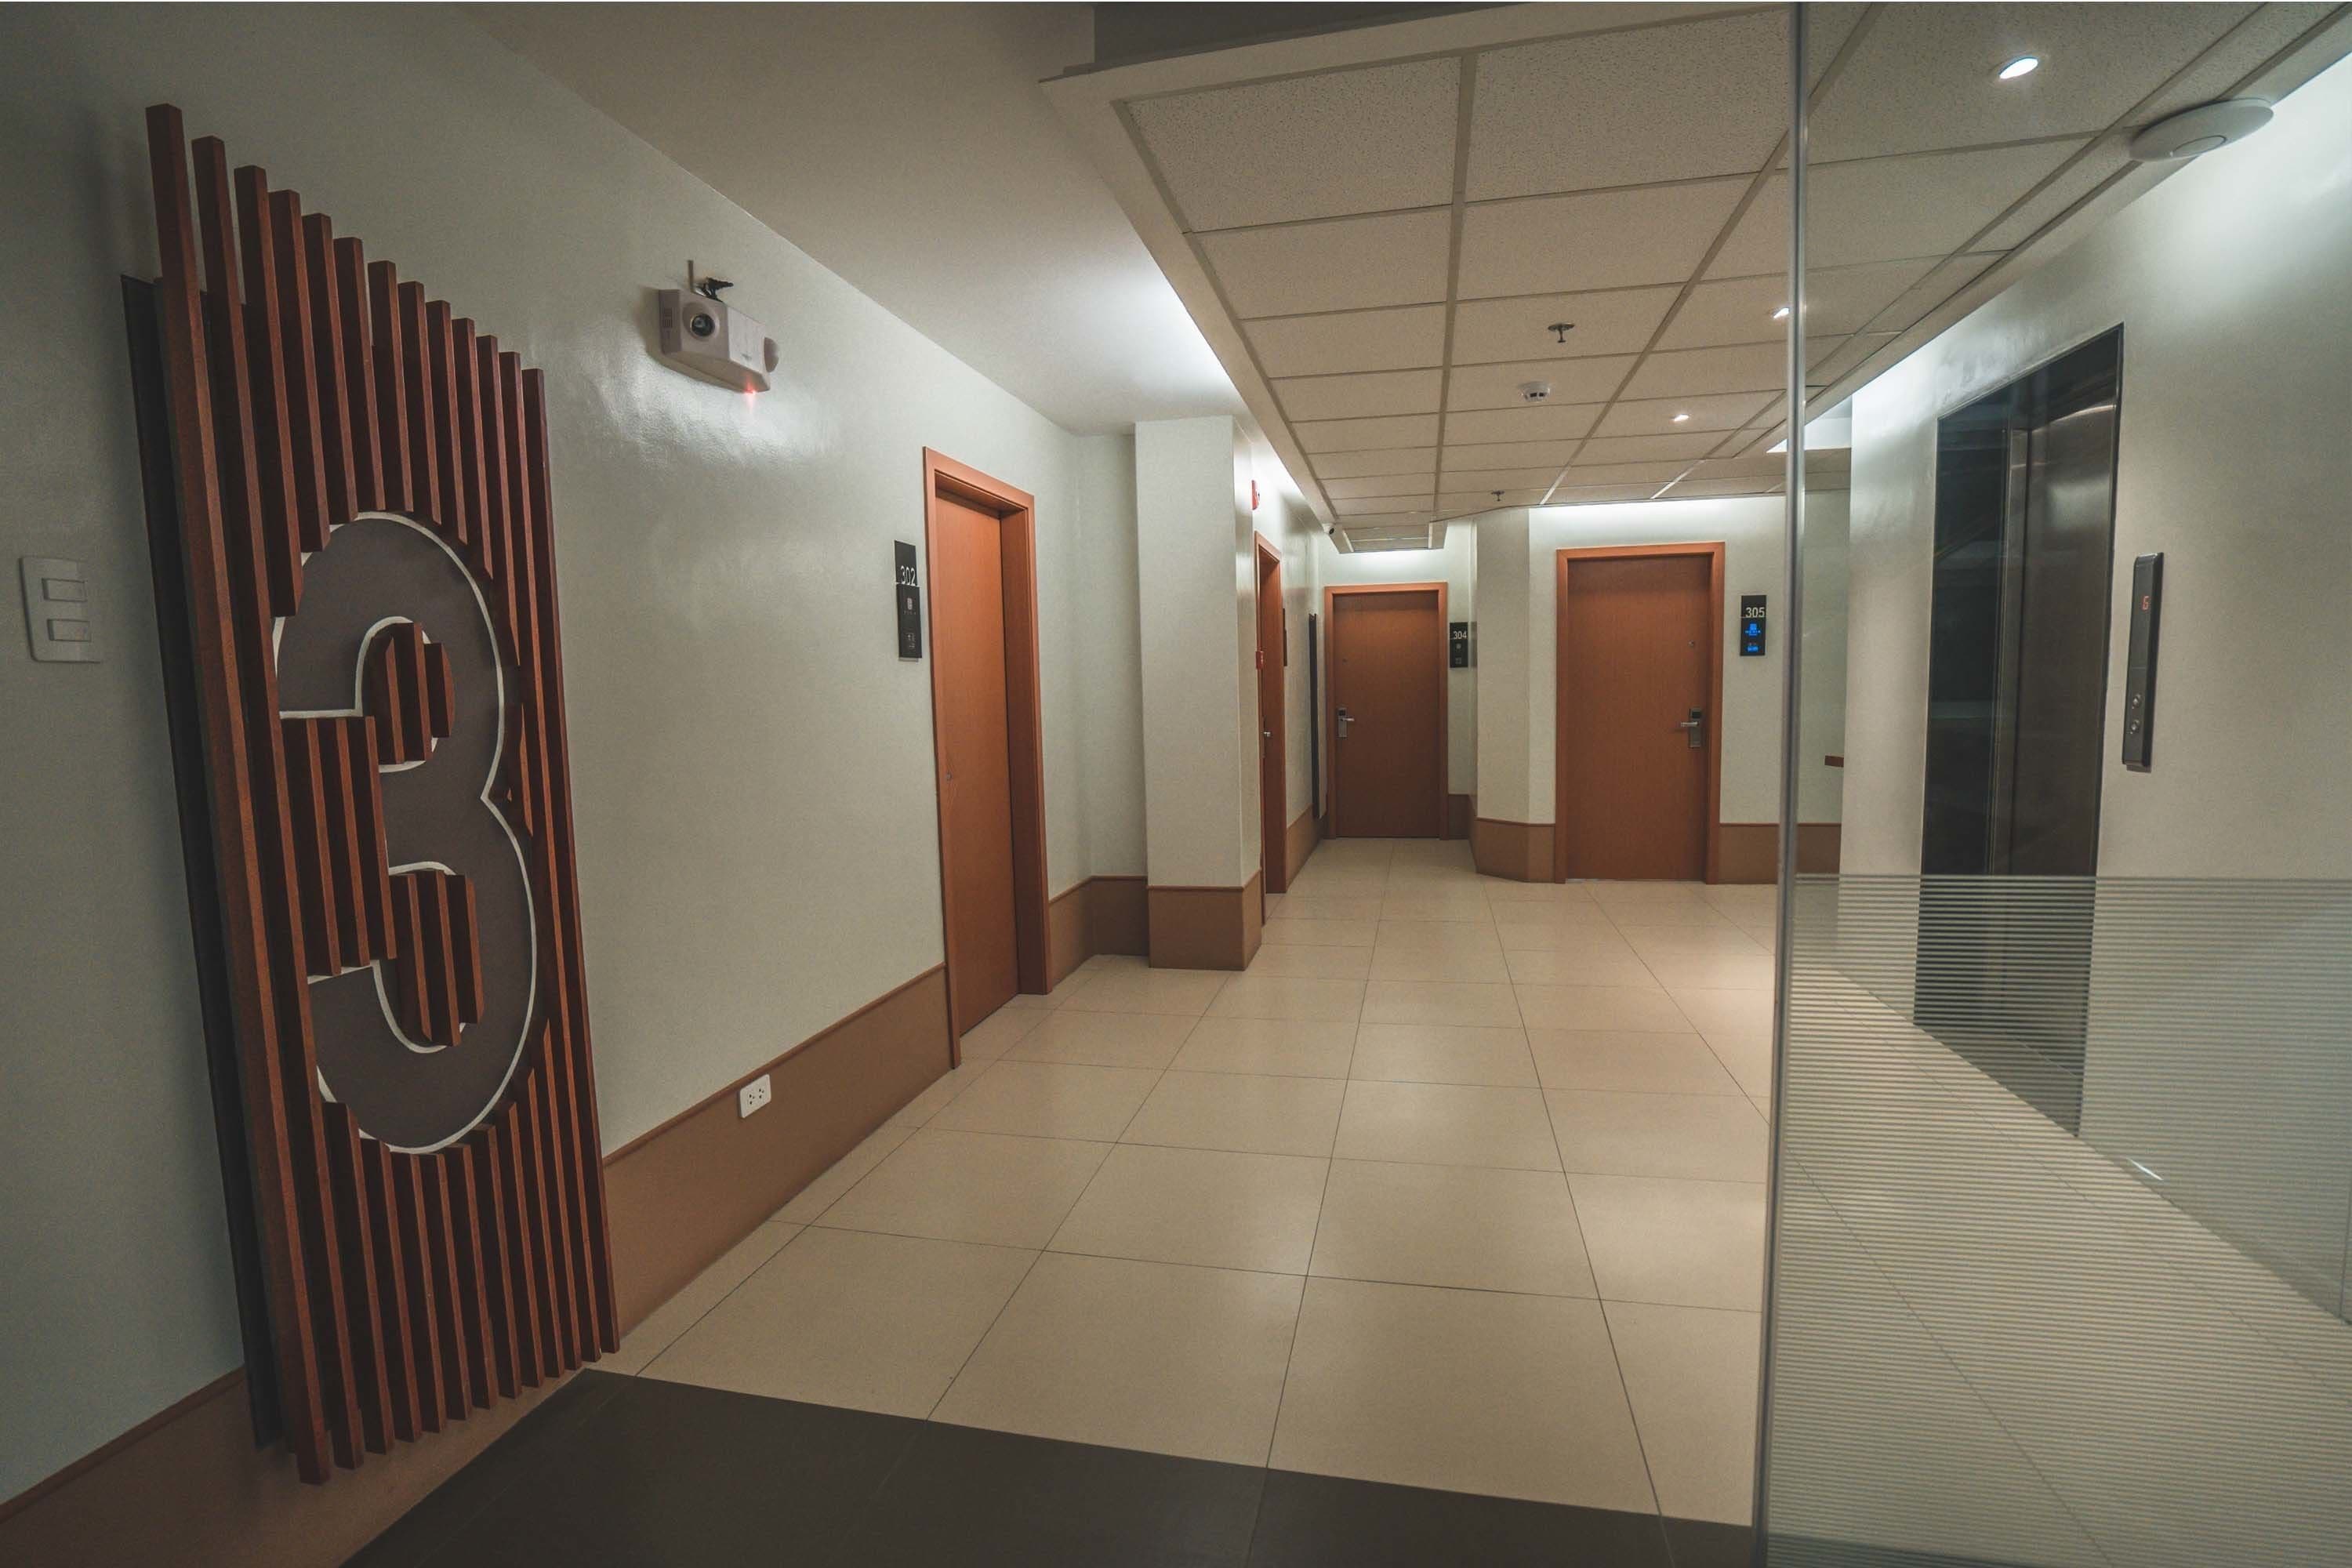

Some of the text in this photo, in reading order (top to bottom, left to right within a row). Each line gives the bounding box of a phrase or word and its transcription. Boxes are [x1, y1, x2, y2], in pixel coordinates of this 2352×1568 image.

[900, 565, 916, 586] 302
[1745, 607, 1765, 618] 305
[1453, 630, 1467, 640] 304
[273, 510, 538, 1154] 3
